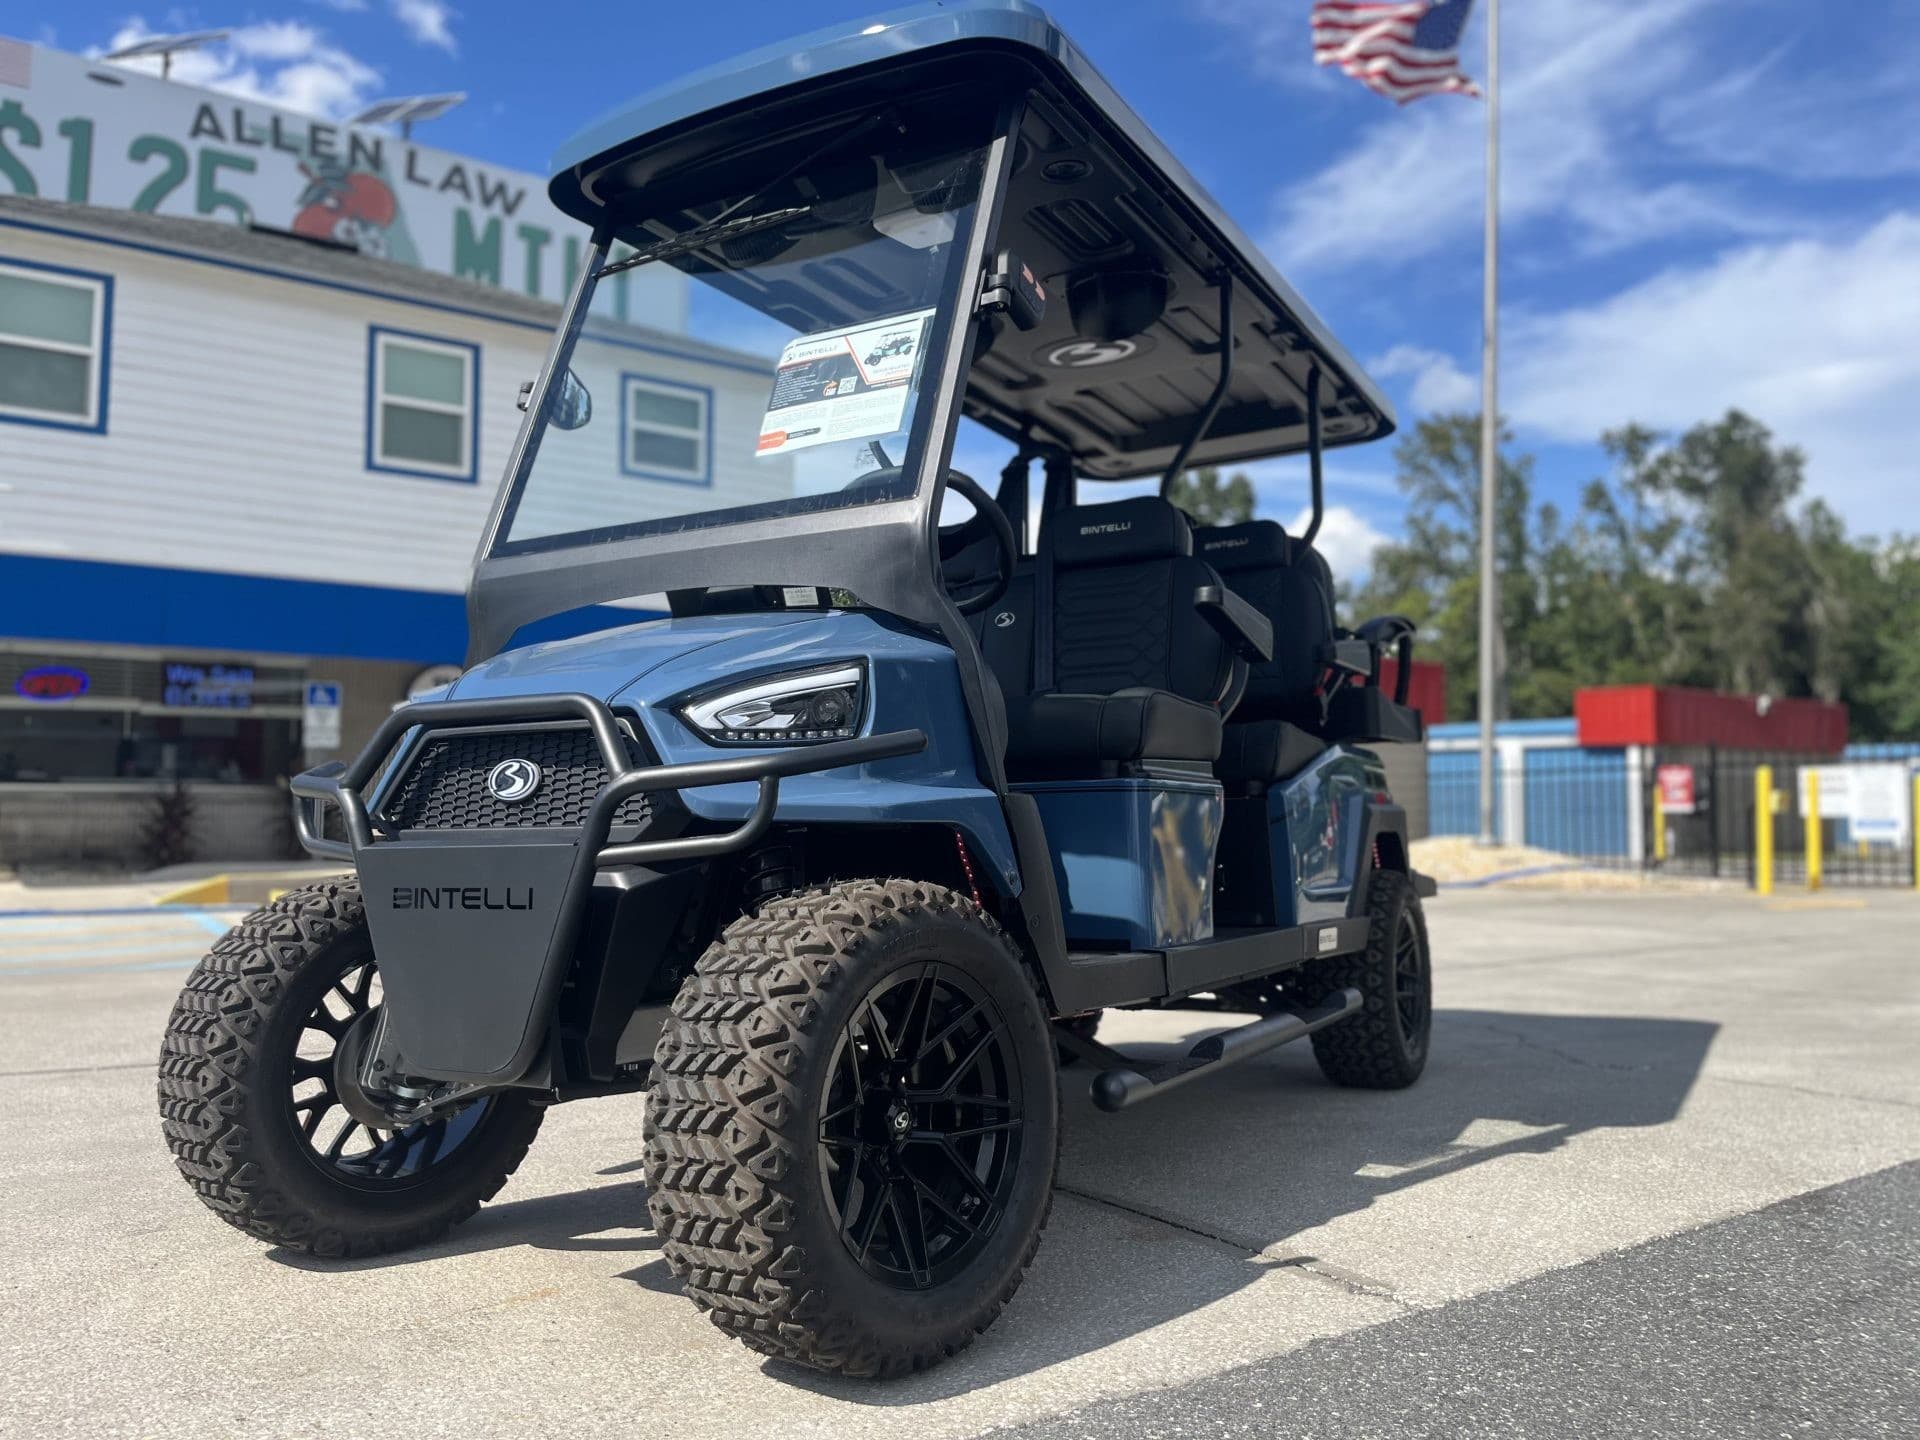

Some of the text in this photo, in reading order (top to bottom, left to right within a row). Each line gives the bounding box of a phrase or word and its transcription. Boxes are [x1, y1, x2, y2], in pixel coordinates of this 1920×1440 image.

[189, 102, 526, 217] ALLEN LAW
[1080, 522, 1131, 535] BINTELLI
[392, 887, 534, 910] BINTELLI
